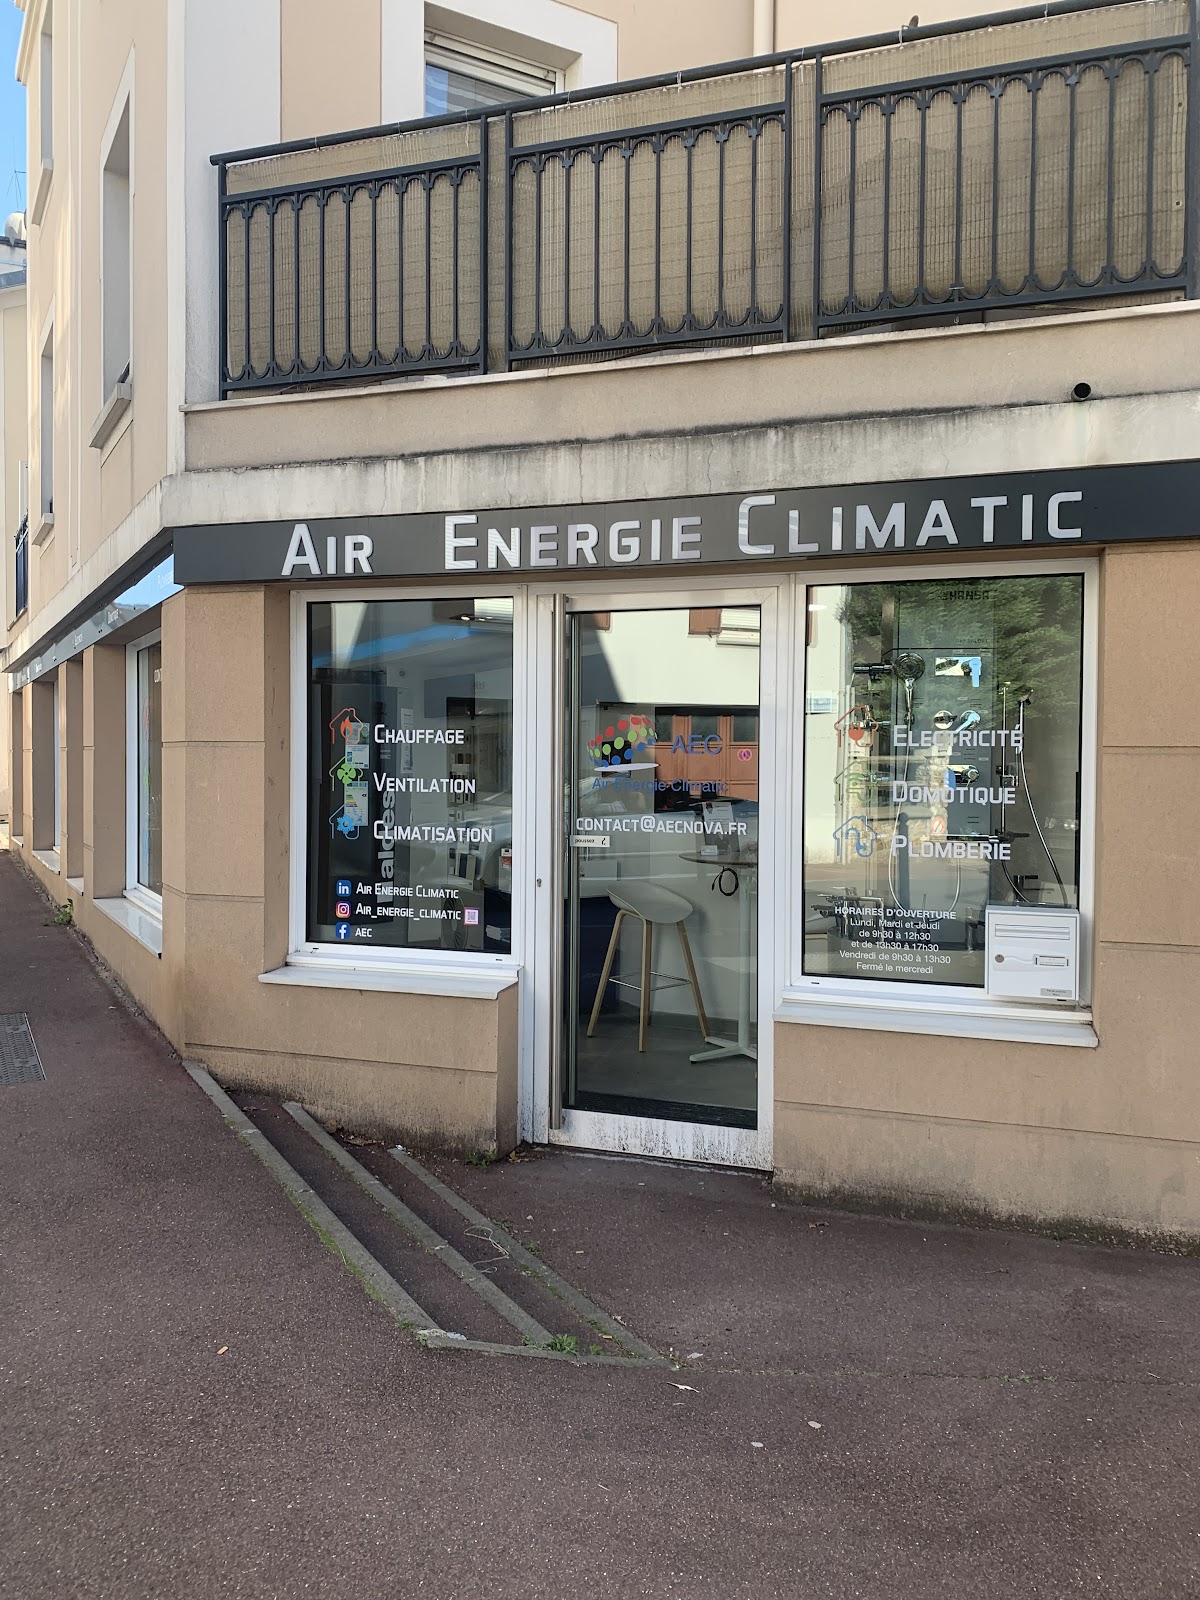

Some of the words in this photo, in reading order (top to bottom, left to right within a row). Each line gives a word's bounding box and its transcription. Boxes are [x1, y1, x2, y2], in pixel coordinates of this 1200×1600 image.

[444, 514, 702, 570] ENERGIE
[738, 491, 1083, 555] CLIMATIC
[374, 724, 465, 744] CHAUFFAGE
[671, 734, 722, 755] AEC
[373, 772, 476, 794] VENTILATION
[592, 777, 609, 790] Air
[615, 777, 666, 794] Energie
[671, 778, 728, 793] Climatic
[892, 780, 1016, 805] DOMOTIQUE
[373, 820, 492, 843] CLIMATISATION
[576, 815, 747, 836] CONTACT@AECNOVA.FR
[892, 834, 1011, 860] PLOMBERIE
[835, 906, 884, 916] HORAIRES
[886, 907, 957, 920] D'OUVERTURE
[355, 928, 372, 938] AEC
[850, 918, 876, 928] Lundi,
[879, 919, 903, 929] Mardi
[905, 921, 915, 929] et
[916, 920, 940, 930] Jeudi
[859, 930, 870, 938] de
[872, 930, 894, 939] 9h30
[896, 930, 901, 939] à
[904, 931, 931, 941] 12h30
[851, 941, 860, 949] et
[861, 940, 873, 949] de
[875, 940, 902, 951] 13h30
[903, 942, 910, 951] à
[912, 942, 939, 952] 17h30
[839, 950, 876, 961] Vendredi
[878, 952, 890, 961] de
[891, 952, 914, 962] 9h30
[916, 953, 922, 962] à
[924, 953, 951, 964] 13h30
[856, 962, 884, 971] Fermé
[885, 962, 893, 972] le
[895, 963, 933, 974] mercredi
